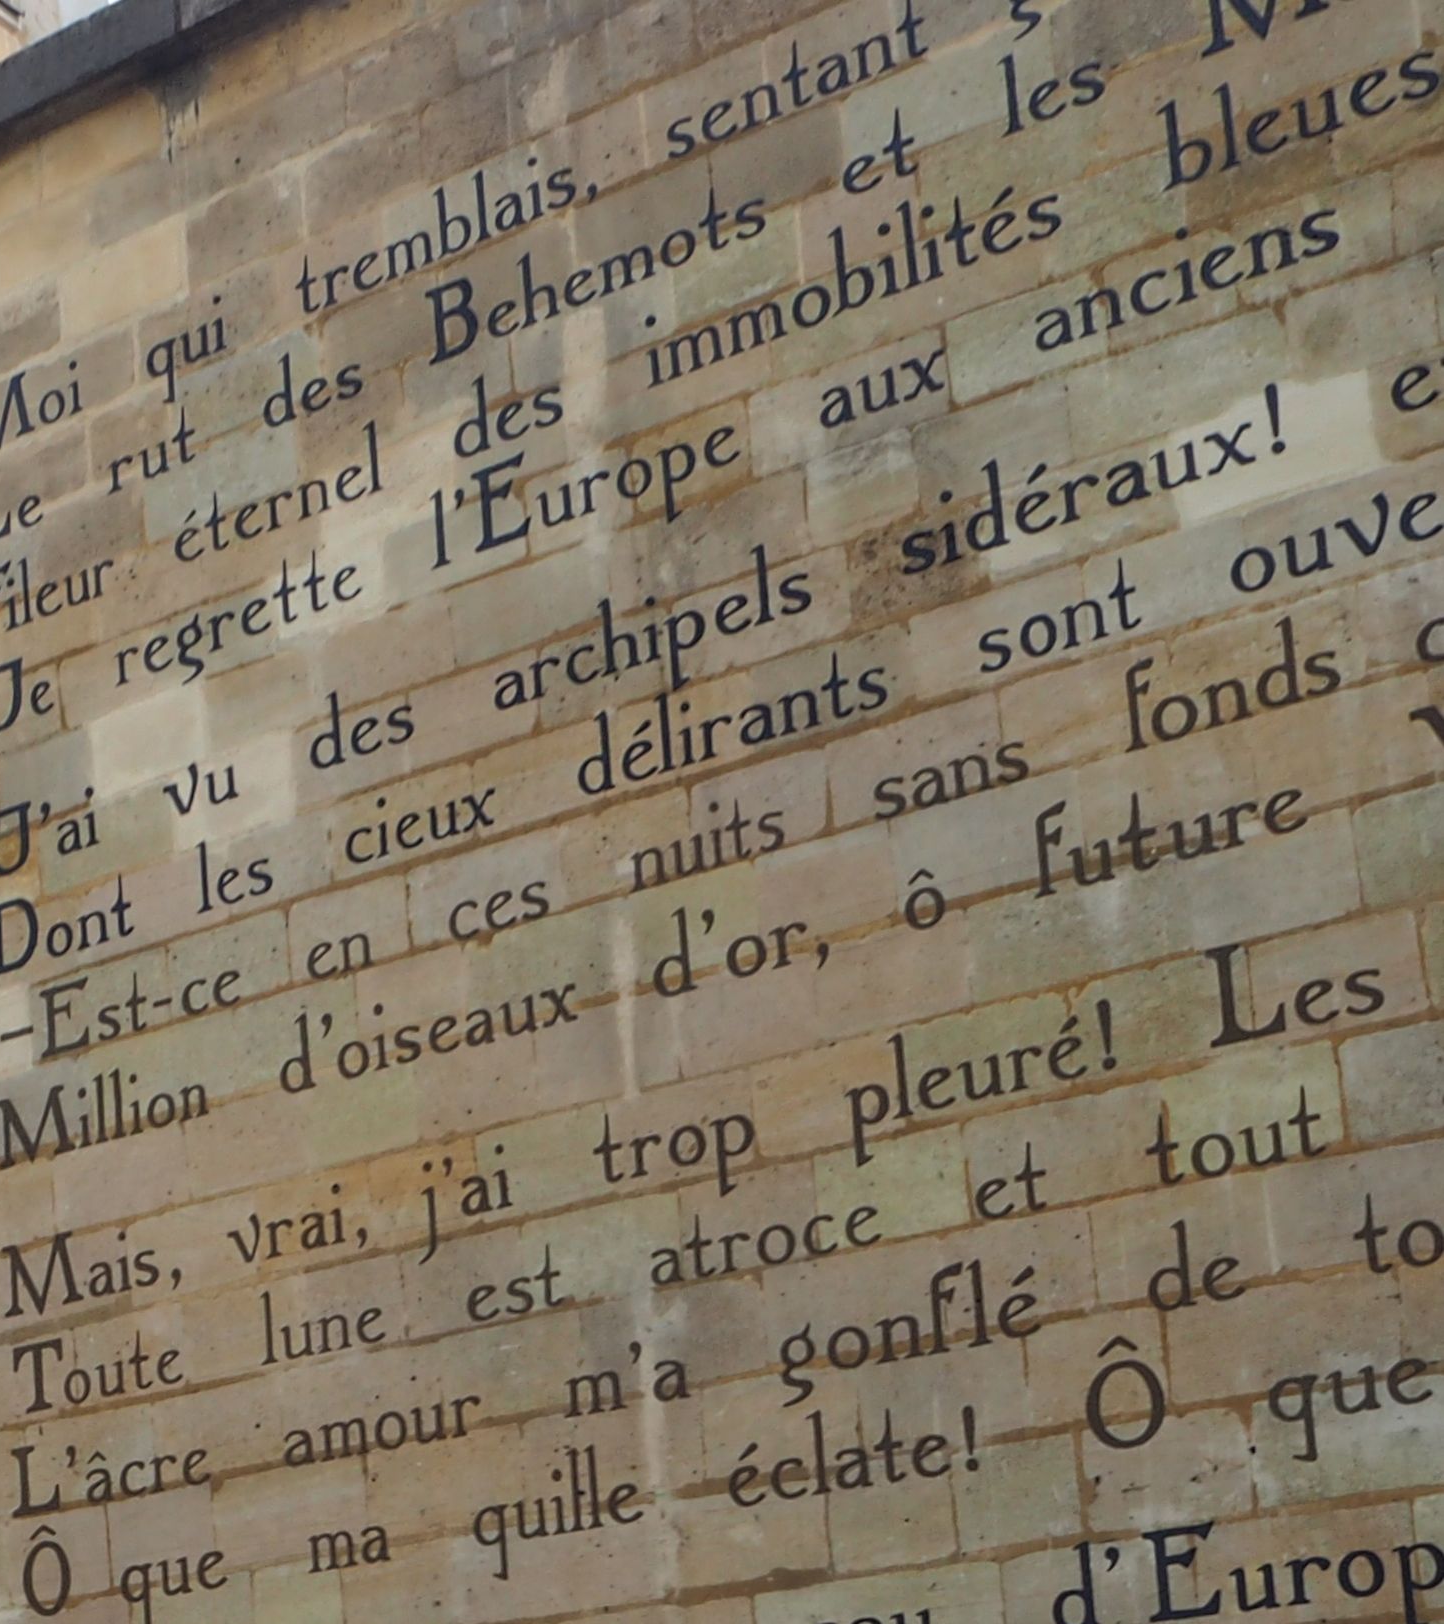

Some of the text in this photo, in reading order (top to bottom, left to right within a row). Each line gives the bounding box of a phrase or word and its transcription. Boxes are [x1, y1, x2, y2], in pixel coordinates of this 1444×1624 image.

[108, 406, 198, 496] rut
[262, 352, 363, 428] des
[425, 188, 767, 364] Behemots
[843, 109, 917, 194] et
[998, 55, 1107, 138] les
[145, 296, 227, 402] qui
[296, 157, 598, 313] tremblais,
[667, 5, 929, 160] sentant
[173, 420, 384, 563] éternel
[452, 376, 563, 460] des
[645, 187, 1063, 388] immobilités
[1157, 49, 1442, 192] bleues
[113, 550, 363, 686] regrette
[429, 424, 741, 570] l'Europe
[819, 344, 947, 429] aux
[1034, 206, 1340, 351] anciens
[164, 763, 238, 816] vu
[310, 692, 415, 769] des
[493, 544, 813, 710] archipels
[901, 383, 1286, 575] sidéraux!
[196, 842, 274, 914] les
[344, 787, 496, 864] cieux
[577, 653, 889, 794] délirants
[978, 560, 1142, 673] sont
[307, 931, 374, 980] en
[449, 878, 549, 941] ces
[631, 800, 785, 892] nuits
[873, 741, 1030, 821] sans
[1126, 618, 1340, 754] fonds
[279, 981, 578, 1094] d'oiseaux
[653, 907, 829, 998] d'or,
[903, 869, 946, 930] ô
[1035, 788, 1309, 899] future
[2, 944, 1386, 1318] Mais, vrai, j'ai trop pleuré! Les
[14, 1085, 1329, 1413] Toute lune est atroce et tout
[12, 1444, 212, 1518] L'âcre
[283, 1392, 482, 1466] amour
[564, 1340, 691, 1420] m'a
[780, 1260, 1043, 1408] gonflé
[1147, 1219, 1245, 1311] de
[22, 1525, 71, 1617] Ô
[308, 1523, 391, 1573] ma
[472, 1444, 644, 1582] quille
[728, 1406, 980, 1508] éclate!
[1087, 1337, 1166, 1450] Ô
[1267, 1356, 1434, 1462] que
